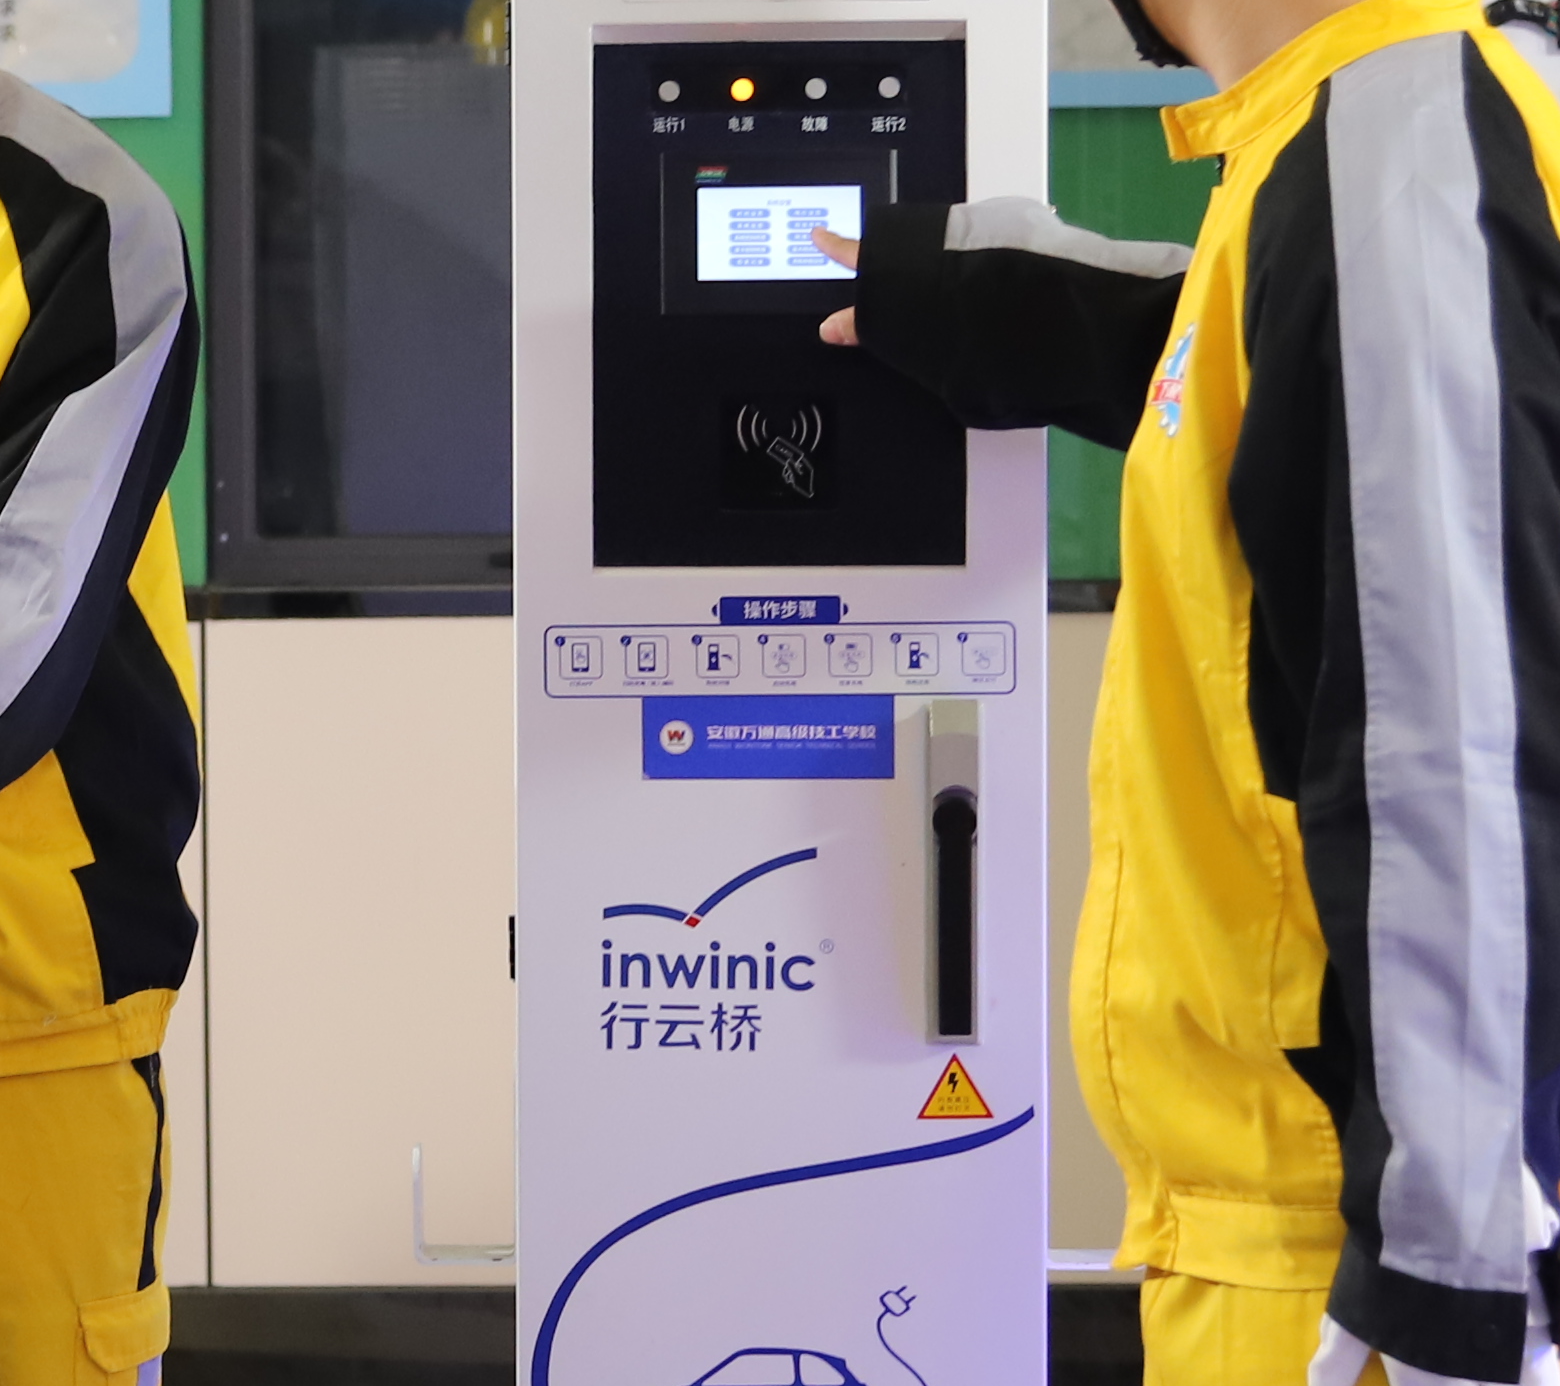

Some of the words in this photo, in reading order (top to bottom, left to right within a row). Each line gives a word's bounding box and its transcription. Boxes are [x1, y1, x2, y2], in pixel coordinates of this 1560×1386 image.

[653, 116, 686, 133] 运行1
[728, 116, 755, 132] 电源
[801, 115, 829, 132] 故障
[871, 115, 907, 133] 运行2
[743, 600, 817, 620] 操作步骤
[601, 940, 816, 991] inwinic
[600, 1001, 762, 1051] 行云桥
